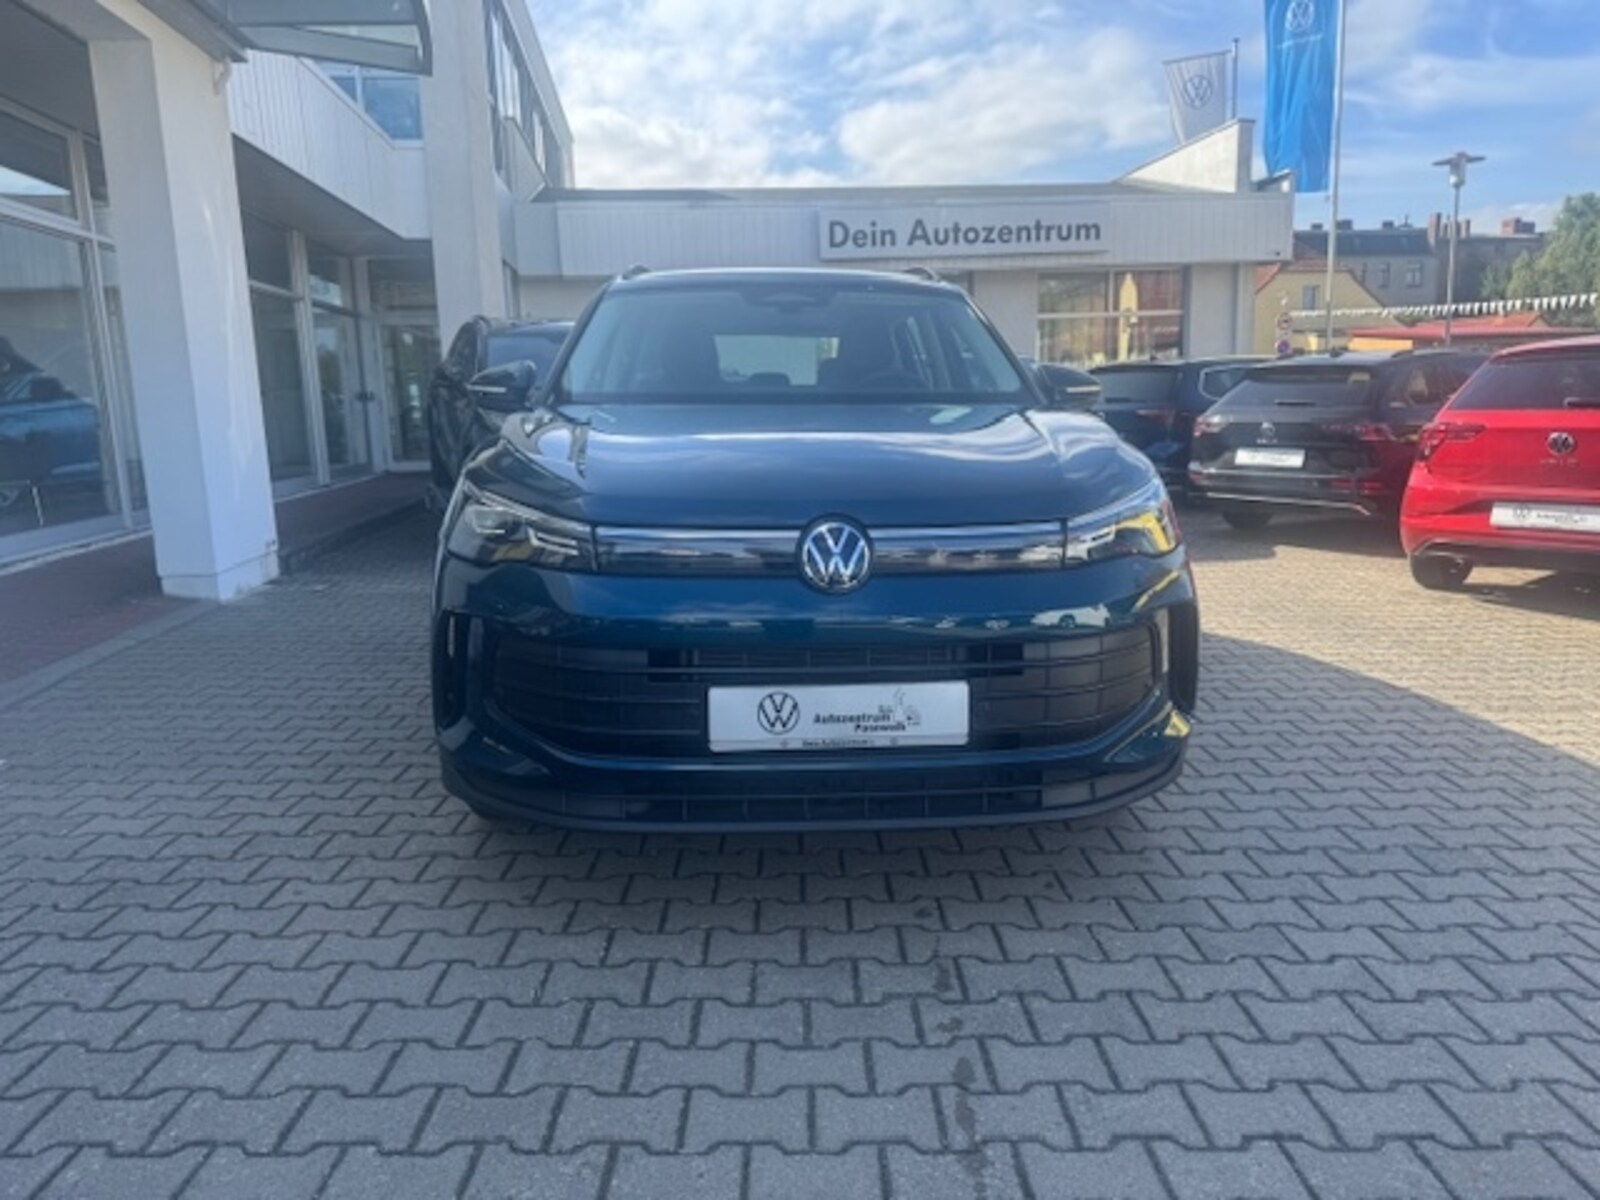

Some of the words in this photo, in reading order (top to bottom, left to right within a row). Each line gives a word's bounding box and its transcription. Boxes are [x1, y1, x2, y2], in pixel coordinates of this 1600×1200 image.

[828, 219, 897, 249] Dein
[906, 218, 1101, 247] Autozentrum
[802, 521, 870, 590] VW
[757, 691, 801, 736] VW
